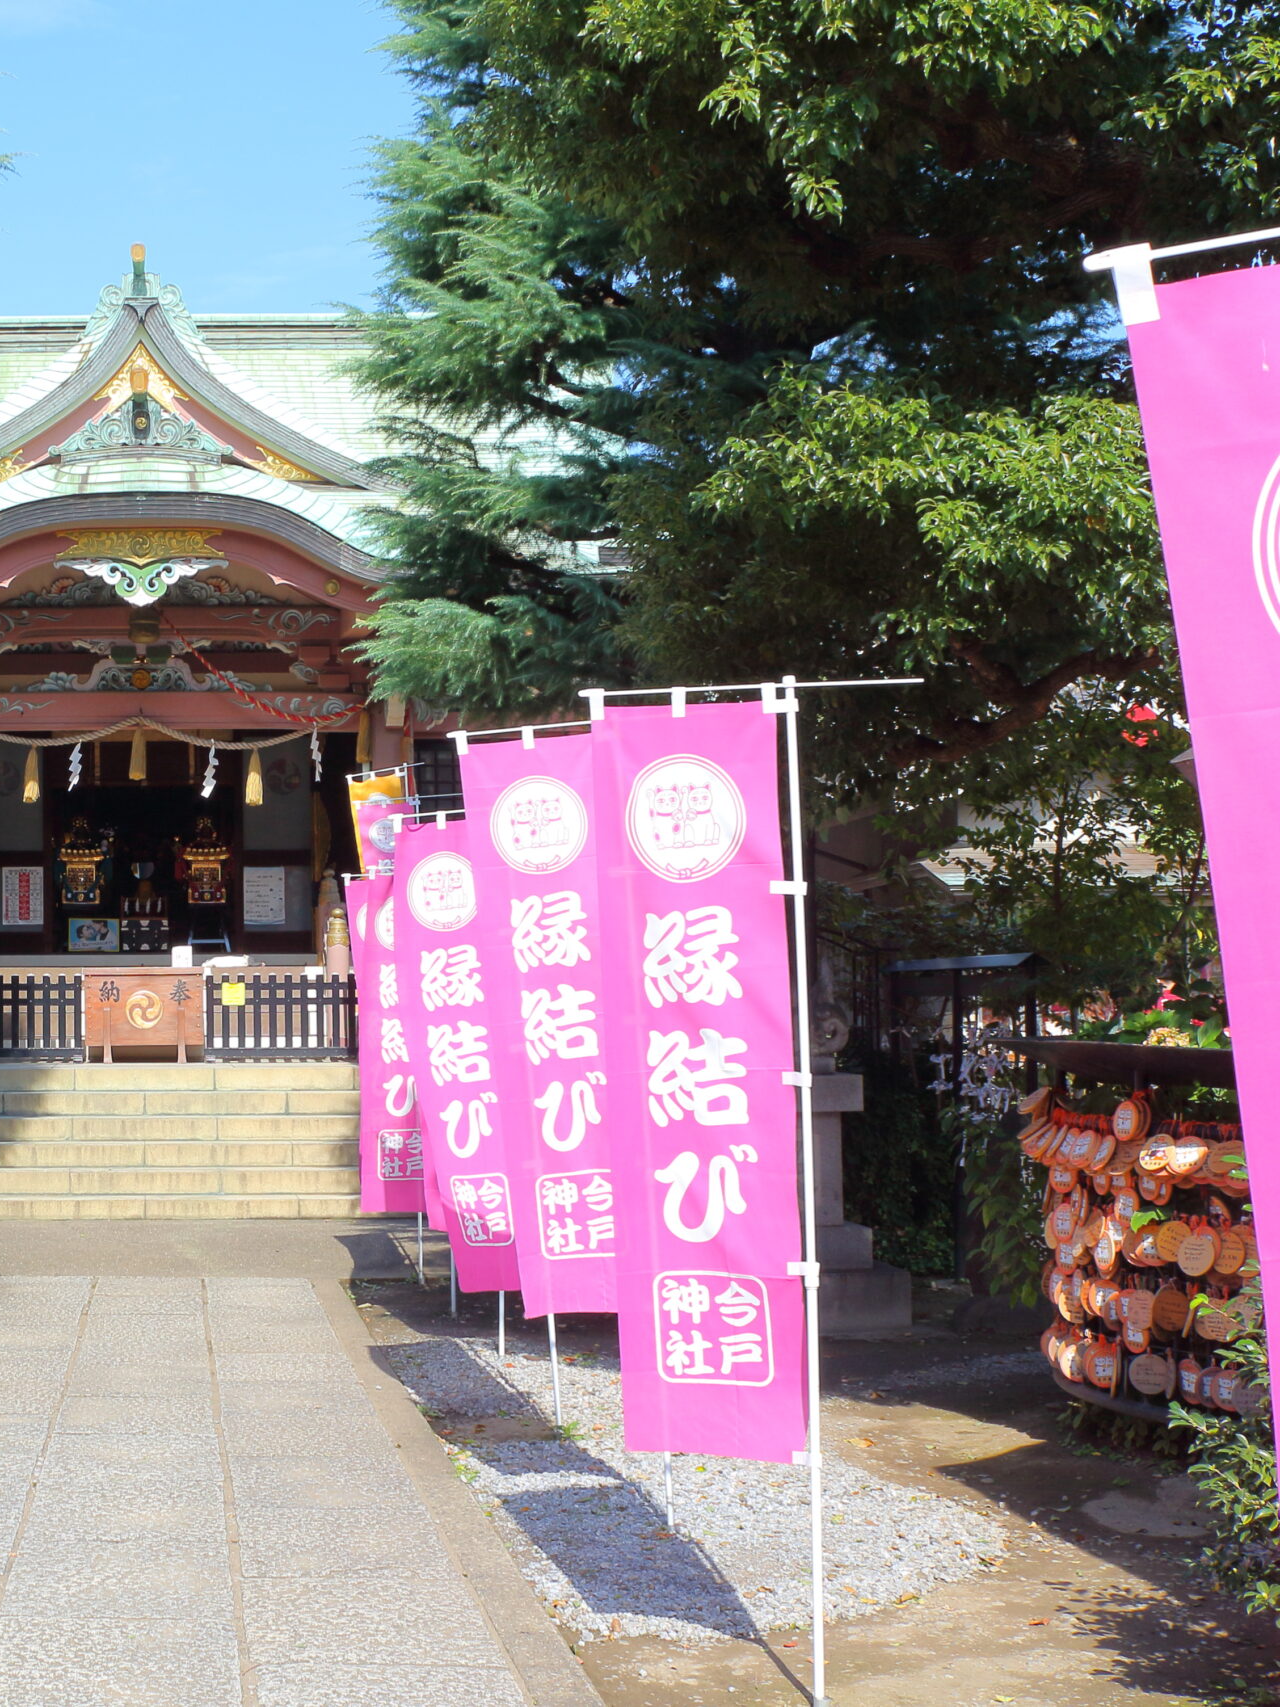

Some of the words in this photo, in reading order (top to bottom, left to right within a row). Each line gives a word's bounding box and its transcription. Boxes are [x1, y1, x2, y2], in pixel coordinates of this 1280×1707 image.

[420, 944, 498, 1159] 縁結び
[510, 890, 607, 1152] 縁結び
[643, 905, 758, 1243] 縁結び
